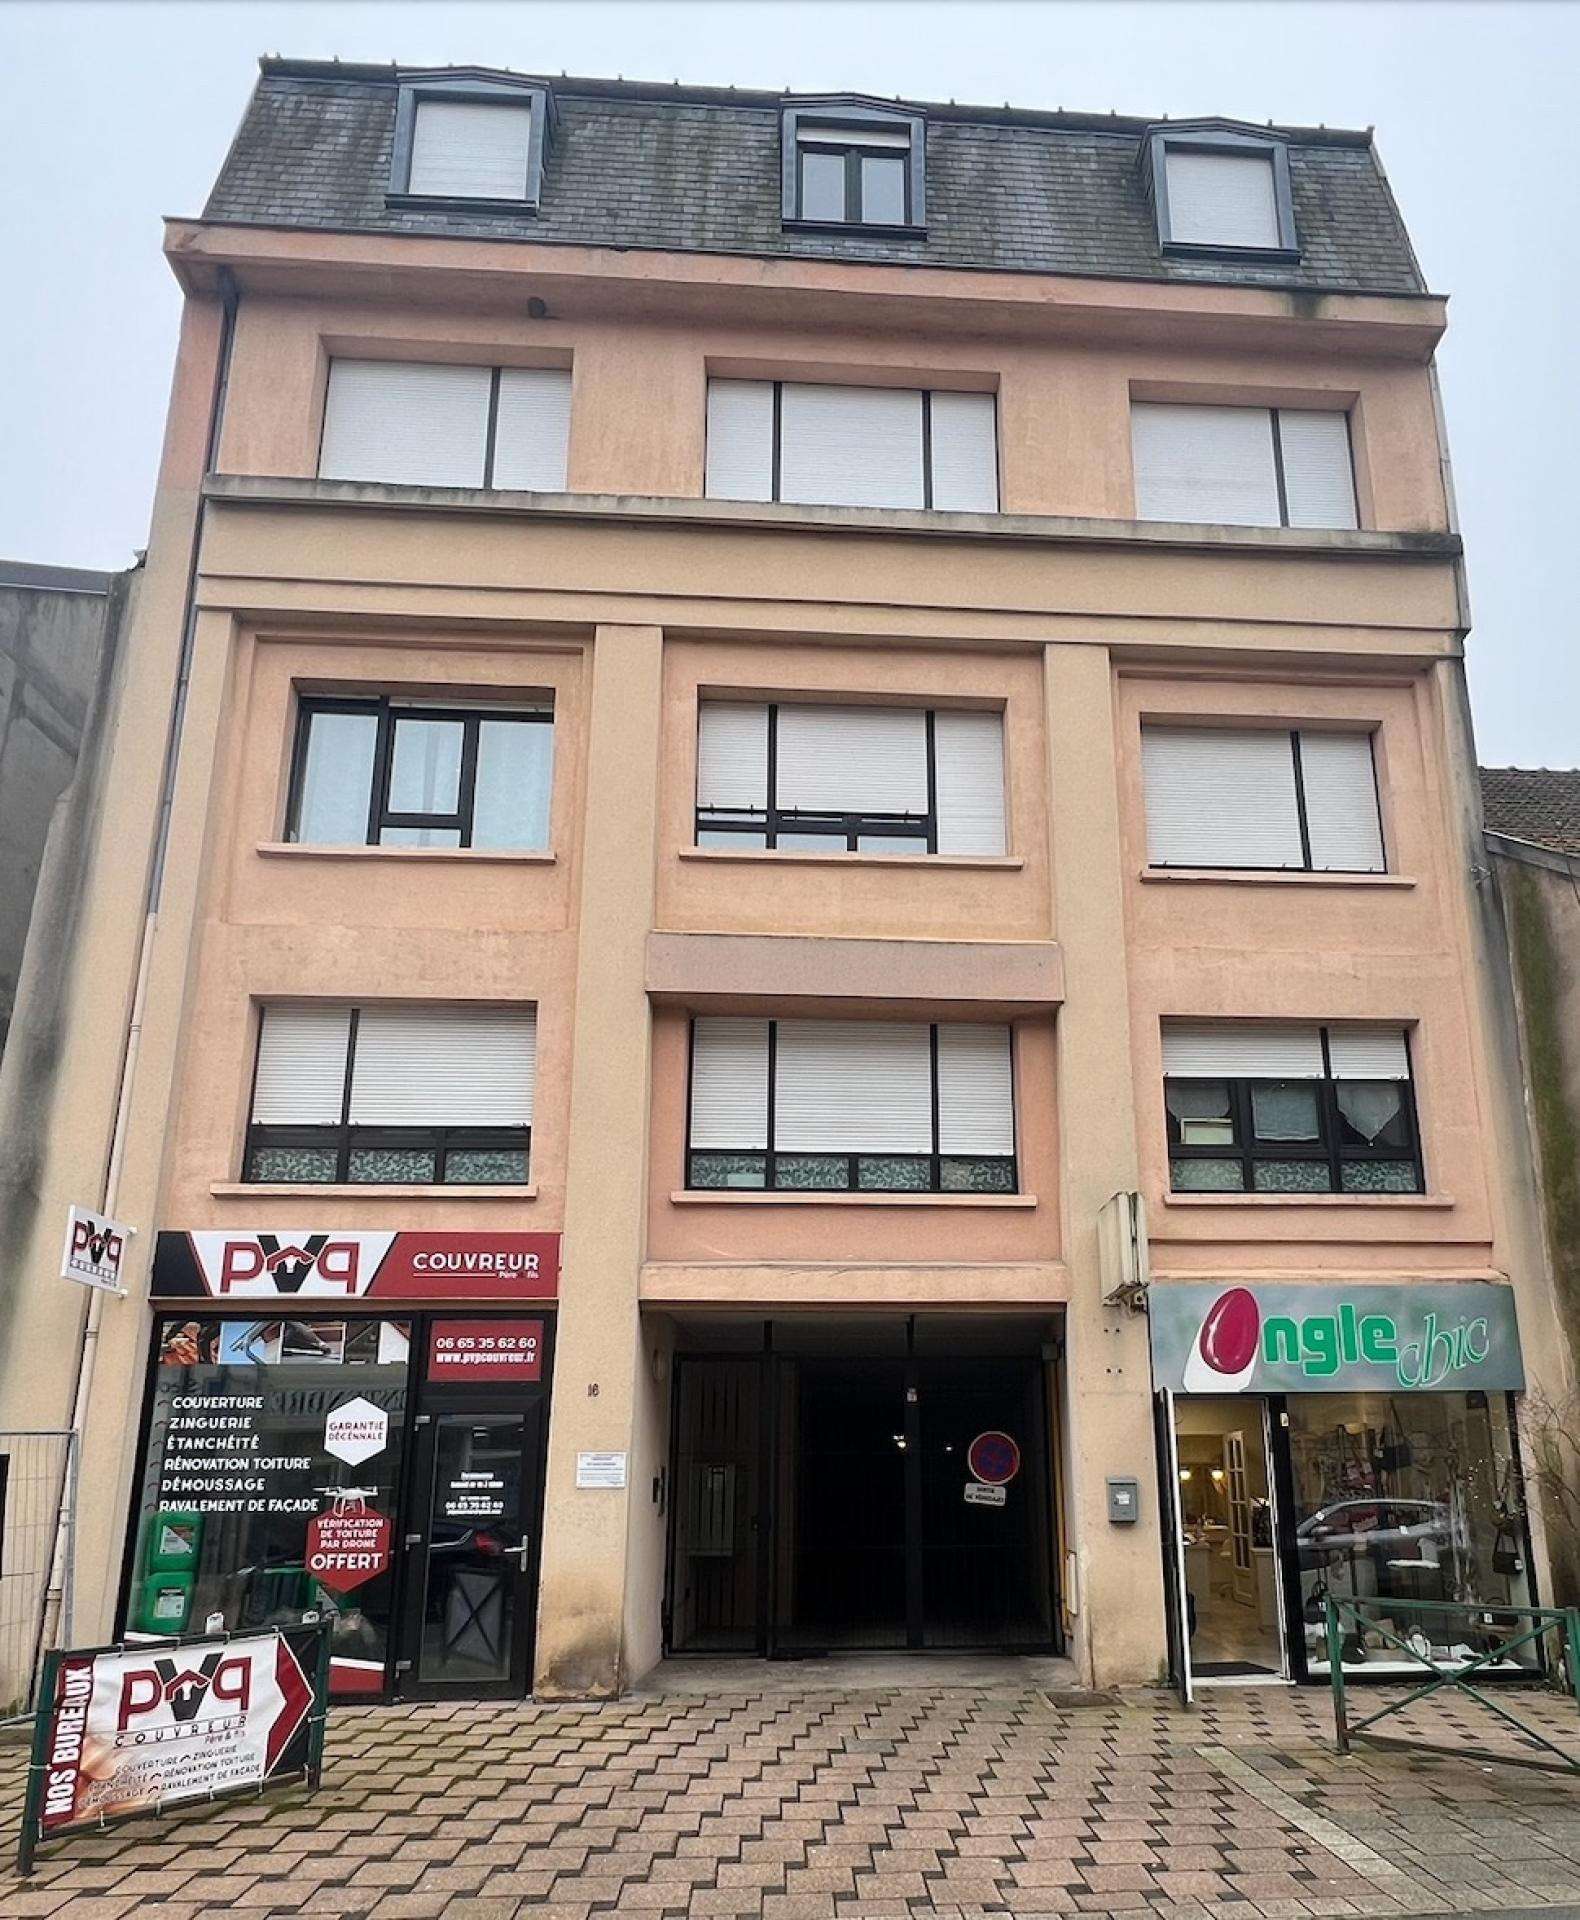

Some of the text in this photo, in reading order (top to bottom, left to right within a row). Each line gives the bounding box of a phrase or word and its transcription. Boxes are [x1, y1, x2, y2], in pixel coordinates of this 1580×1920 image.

[413, 1252, 540, 1270] COUVREUR
[436, 1337, 537, 1349] 06 65 35 62 60
[172, 1396, 264, 1409] COUVERTURE
[169, 1417, 252, 1429] ZINGUERIE
[328, 1421, 384, 1431] GARANTIE
[167, 1435, 260, 1450] ÉTANCHÉITÉ
[164, 1456, 312, 1471] RÉNOVATION TOITURE
[162, 1477, 266, 1491] DÉMOUSSAGE
[159, 1499, 319, 1514] RAVALEMENT DE FAÇADE
[317, 1519, 384, 1528] VÉRIFICATION
[320, 1529, 379, 1538] DE TOITURE
[320, 1540, 377, 1549] PAR DRONE
[310, 1553, 383, 1570] OFFERT
[115, 1715, 247, 1747] COUVREUR
[45, 1664, 92, 1815] NOS BUREAUX
[193, 1745, 237, 1761] ZINGUERIE
[220, 1754, 256, 1768] TOITURE
[217, 1770, 228, 1781] DE
